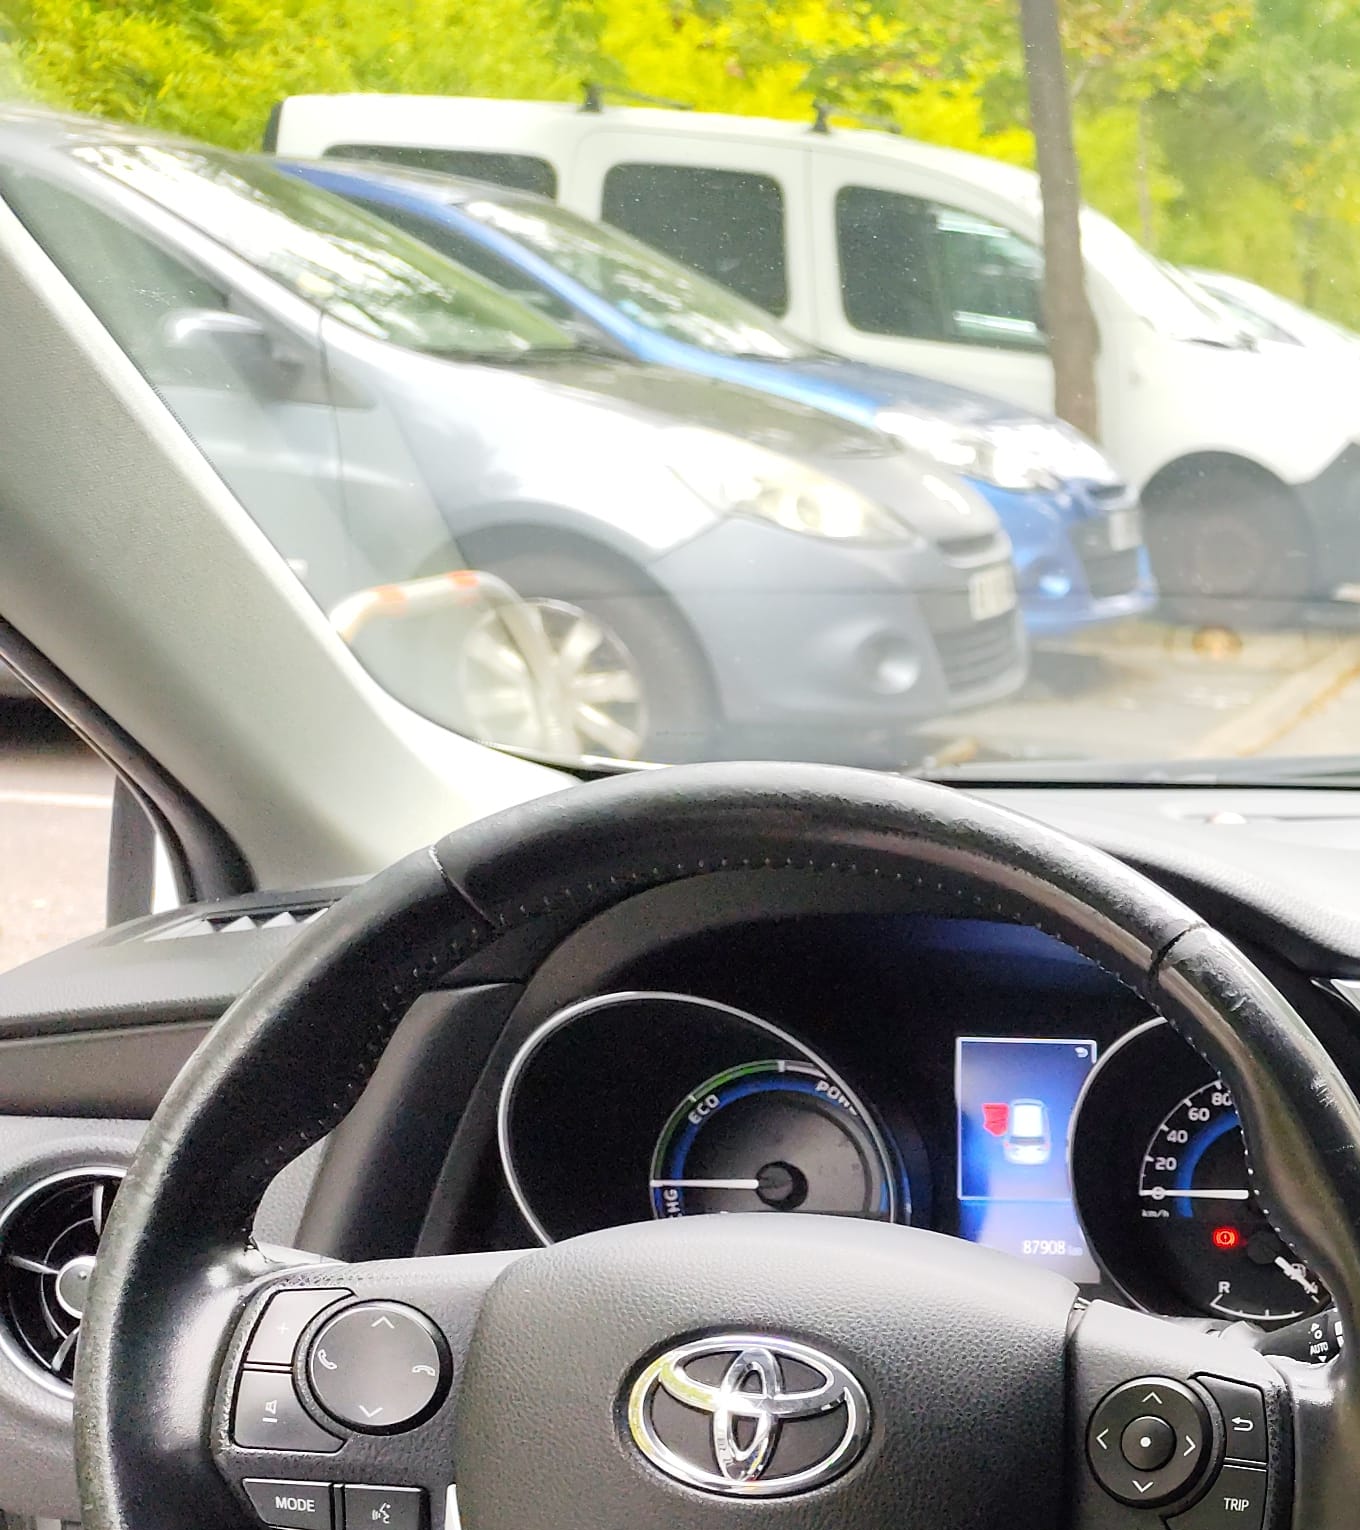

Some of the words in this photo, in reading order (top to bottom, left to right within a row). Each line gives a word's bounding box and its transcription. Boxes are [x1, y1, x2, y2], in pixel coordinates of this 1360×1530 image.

[687, 1093, 721, 1125] ECO
[1188, 1107, 1210, 1121] 60
[1166, 1130, 1188, 1143] 40
[1154, 1157, 1177, 1171] 20
[1141, 1209, 1169, 1218] km/h
[1023, 1240, 1066, 1255] 87908
[1218, 1281, 1231, 1293] R
[1310, 1341, 1329, 1355] AUTO
[275, 1496, 316, 1513] MODE
[1223, 1497, 1250, 1512] TRIP
